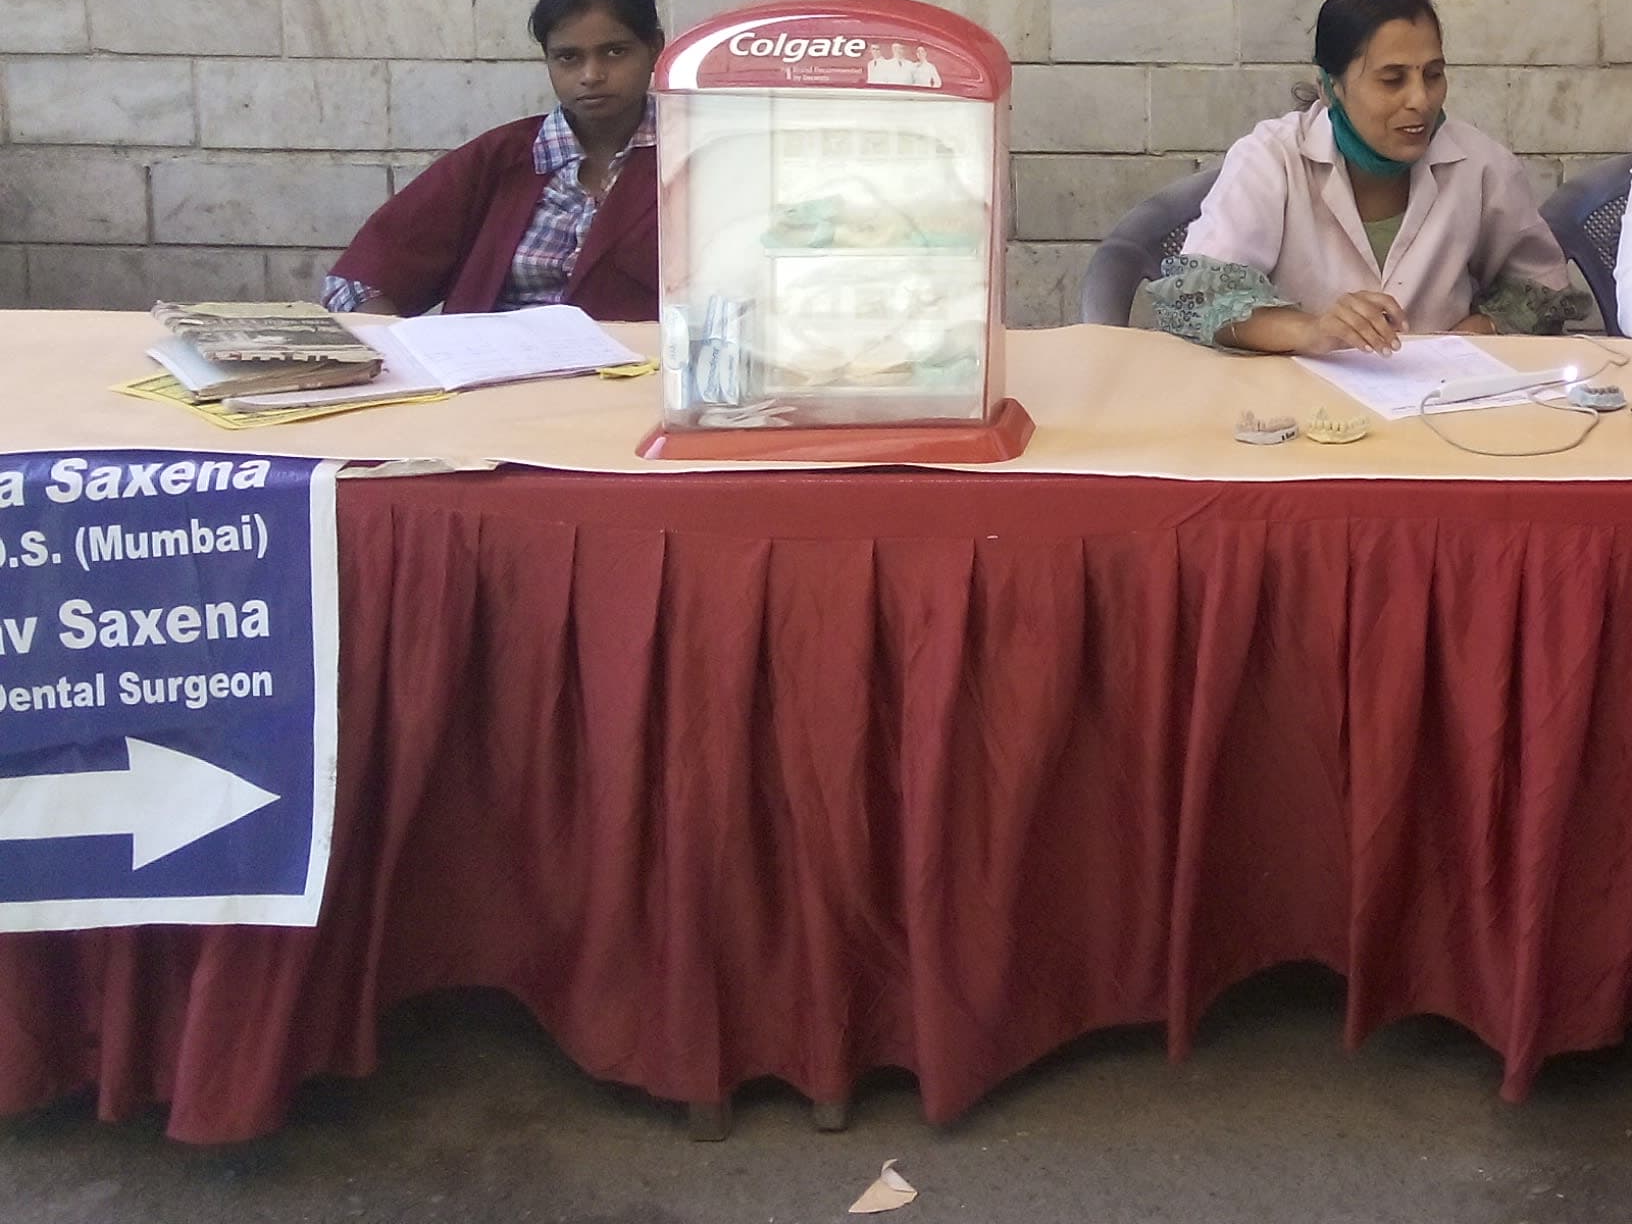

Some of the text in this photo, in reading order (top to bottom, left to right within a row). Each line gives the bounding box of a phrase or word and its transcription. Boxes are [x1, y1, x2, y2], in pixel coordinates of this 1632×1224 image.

[729, 32, 866, 62] Colgate
[45, 458, 272, 503] Saxena
[0, 514, 269, 571] .S. (Mumbai)
[0, 599, 270, 656] v Saxena
[118, 670, 273, 709] Surgeon
